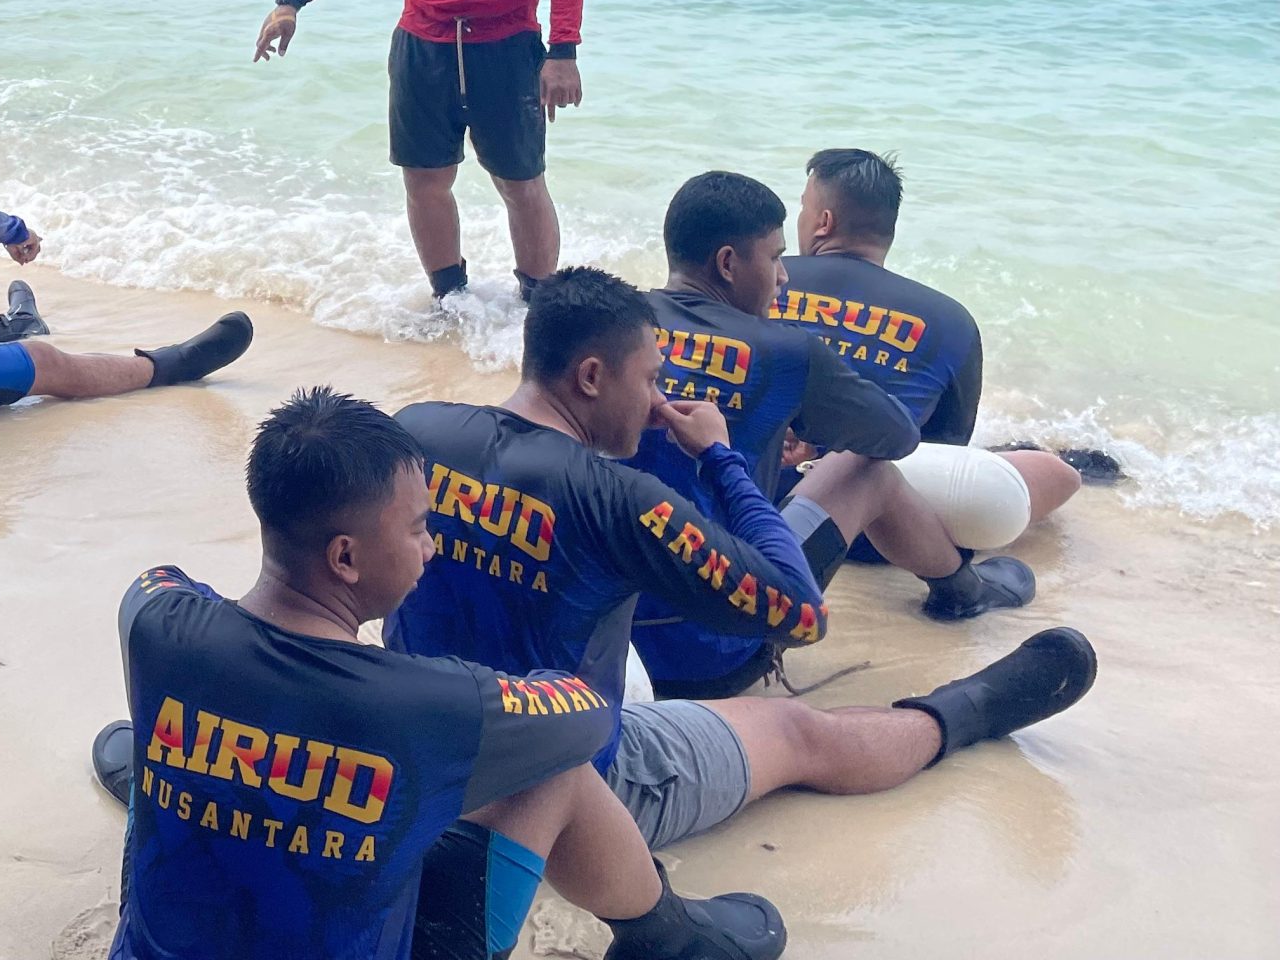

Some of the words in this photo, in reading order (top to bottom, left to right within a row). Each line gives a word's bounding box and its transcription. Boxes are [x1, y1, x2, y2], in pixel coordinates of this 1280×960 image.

[428, 463, 556, 561] IRUD
[433, 533, 548, 593] ANTARA
[639, 500, 829, 644] ARNAVA
[147, 695, 395, 825] AIRUD
[142, 765, 376, 863] NUSANTARA
